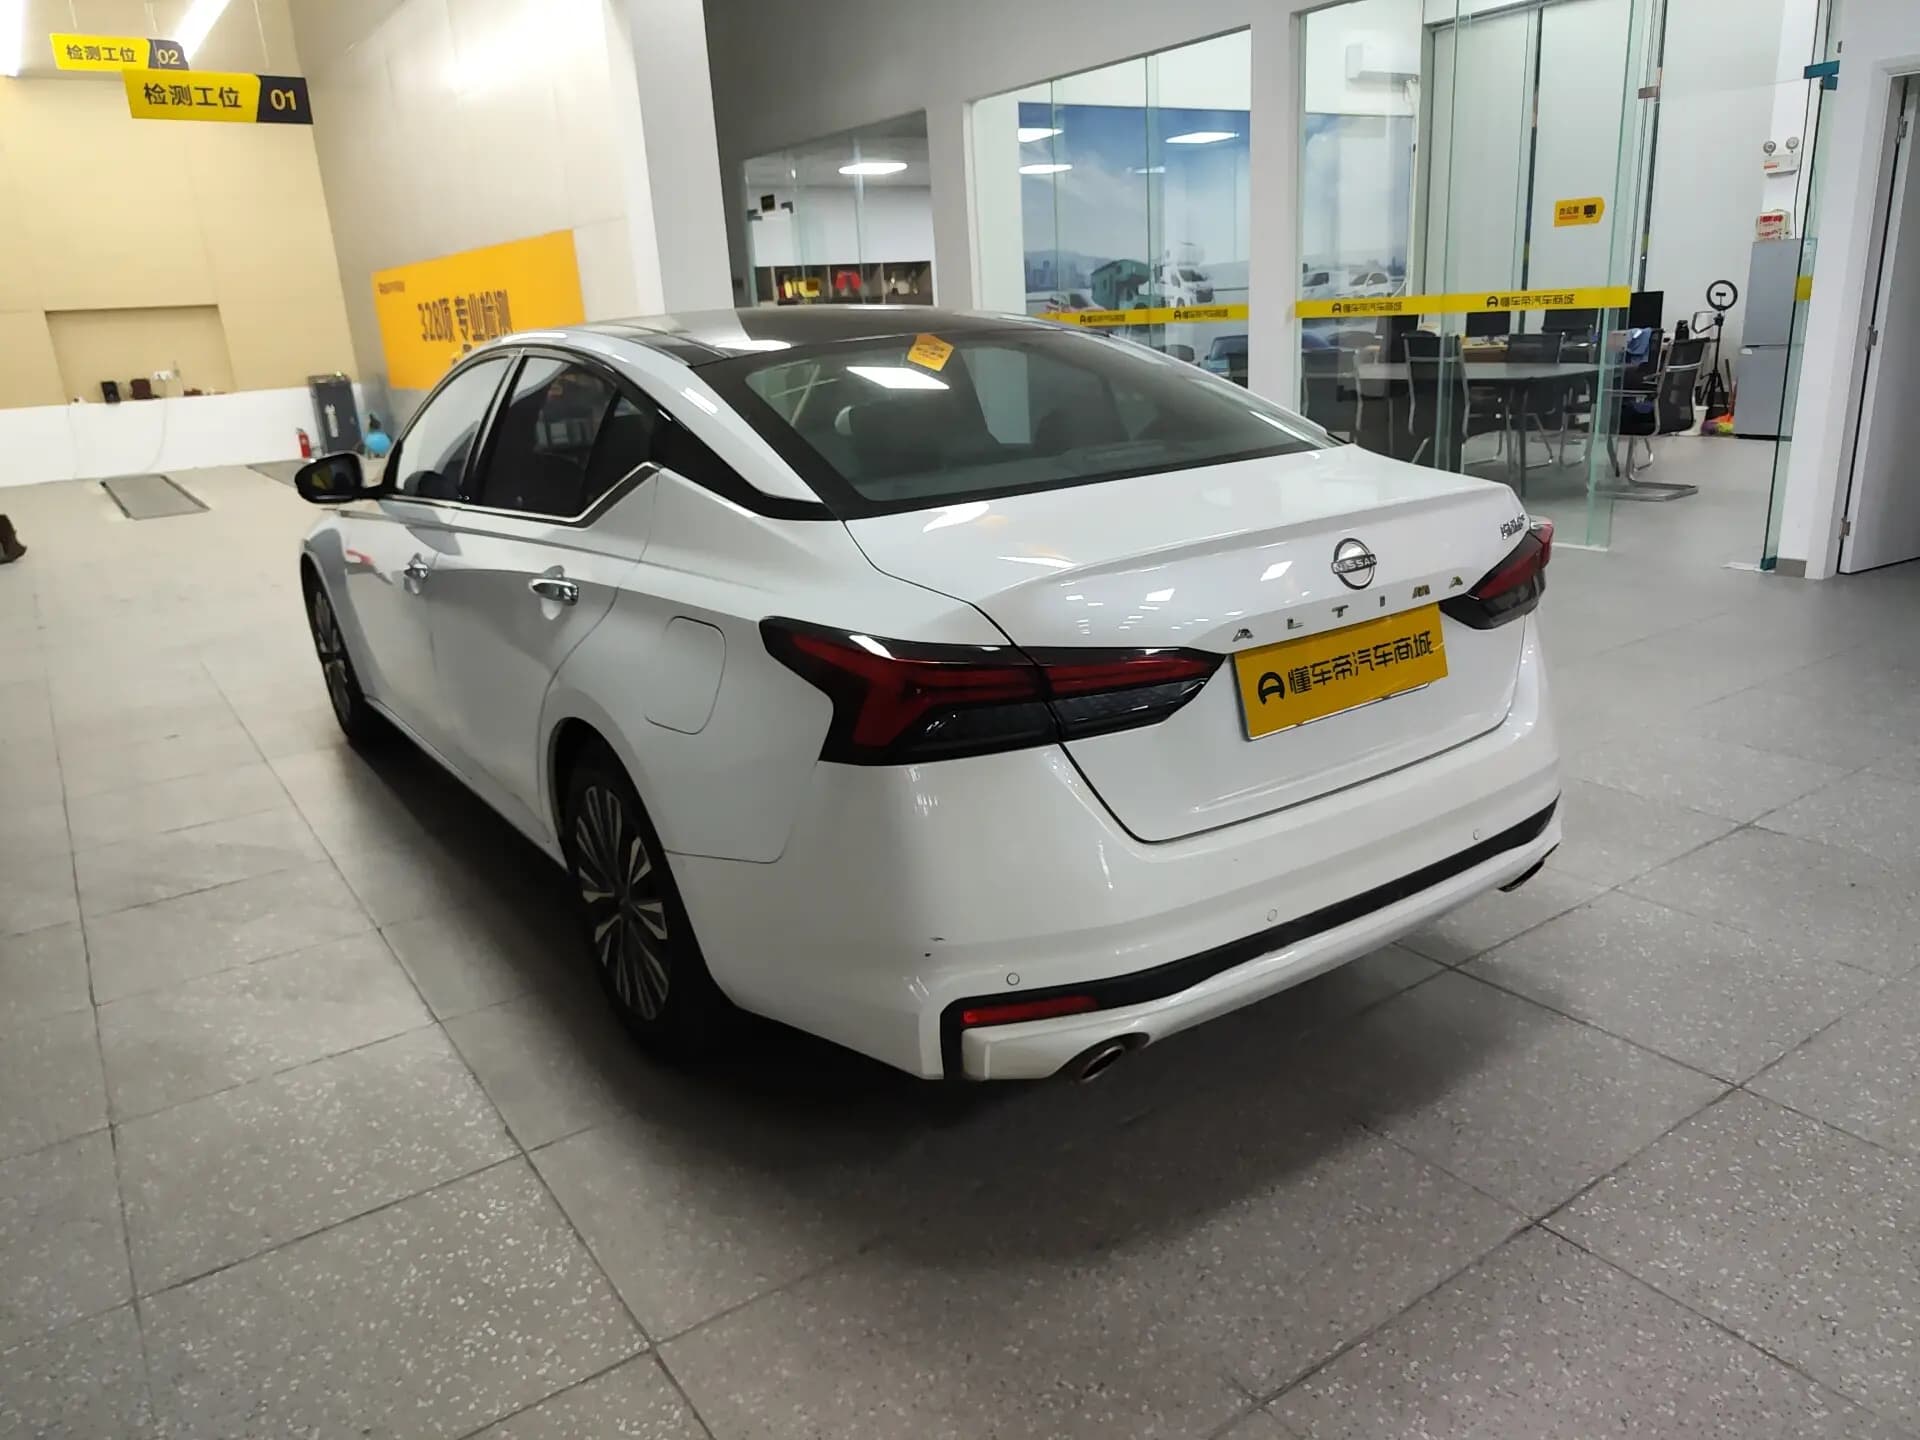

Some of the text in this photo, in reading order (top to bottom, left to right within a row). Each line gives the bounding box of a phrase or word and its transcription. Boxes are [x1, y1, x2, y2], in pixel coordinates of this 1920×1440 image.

[66, 43, 180, 65] 检测工位 02
[143, 82, 297, 111] 检测工位 01
[1332, 555, 1376, 573] NISSAN
[1232, 576, 1464, 642] ALTIMA
[1287, 630, 1435, 695] 懂车帝汽车商城
